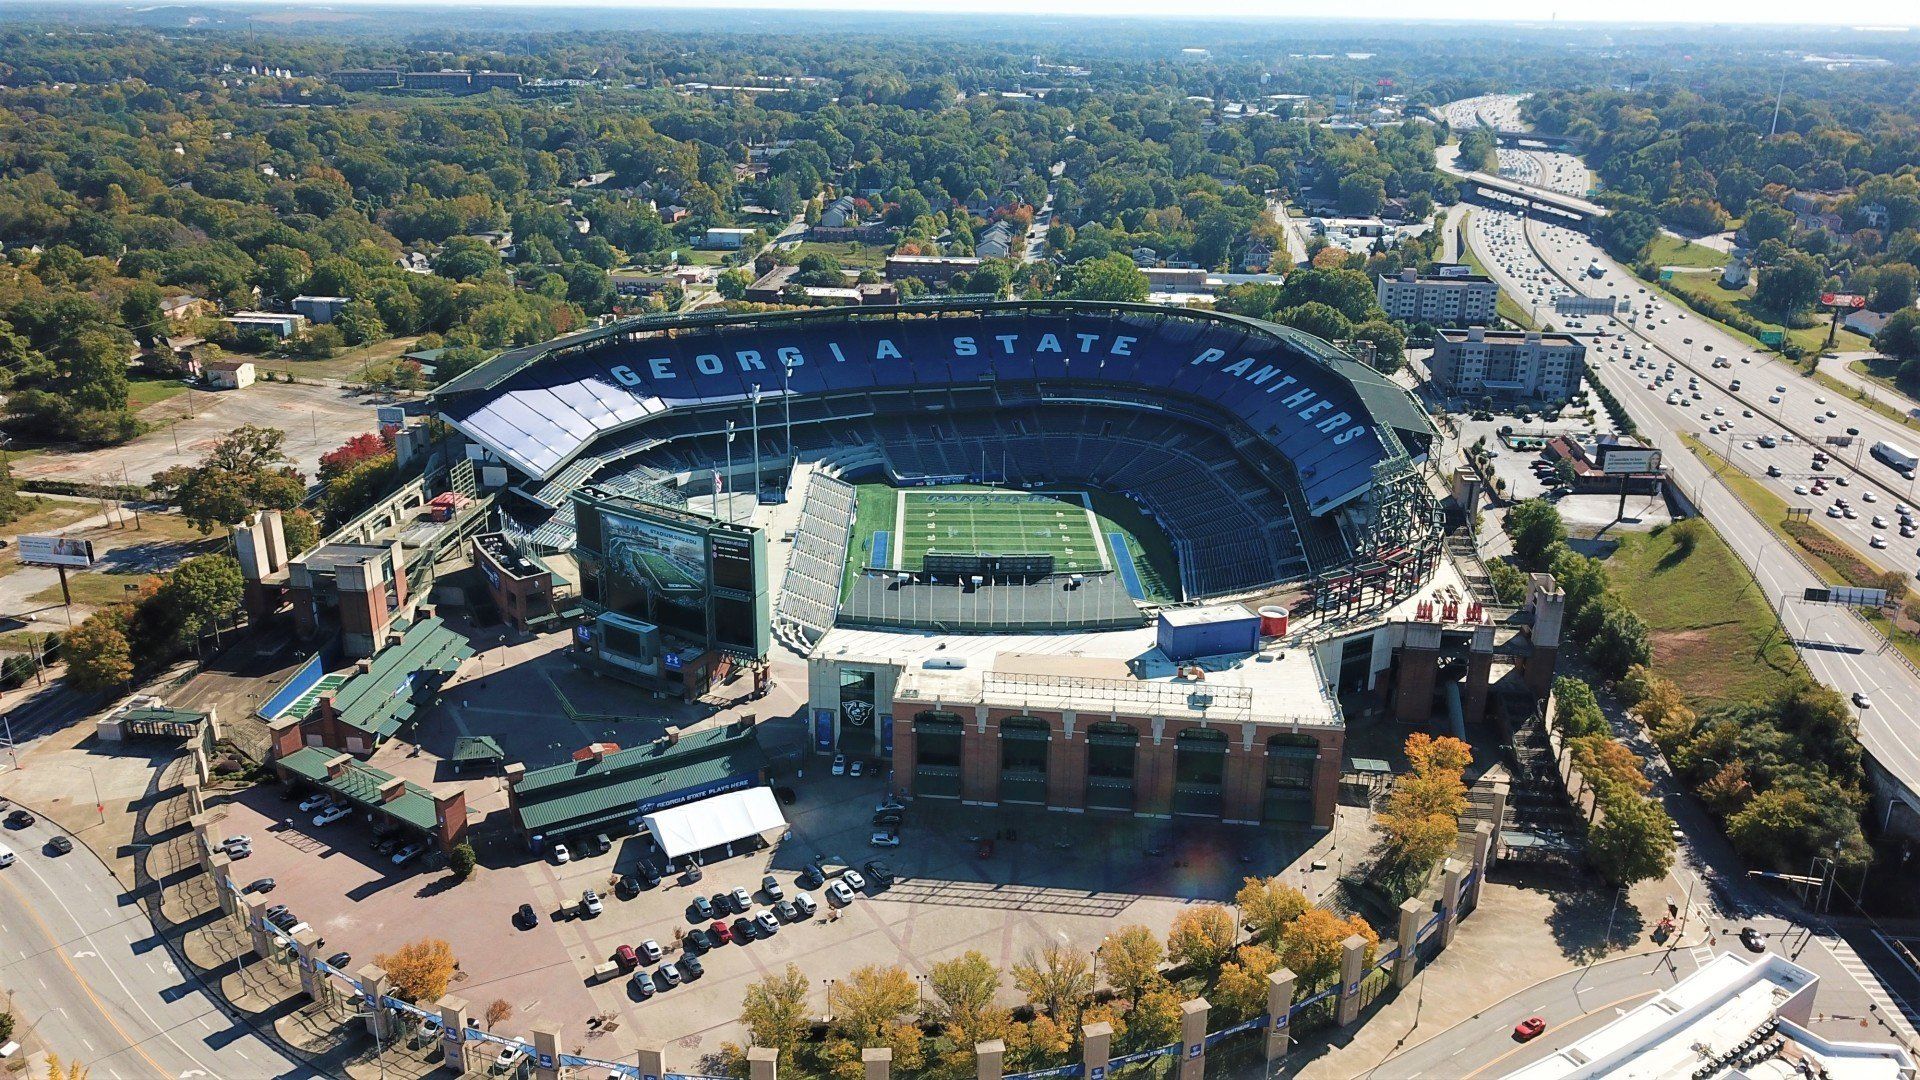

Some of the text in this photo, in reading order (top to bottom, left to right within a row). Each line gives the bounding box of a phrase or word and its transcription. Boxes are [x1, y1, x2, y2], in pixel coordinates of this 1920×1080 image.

[611, 333, 1366, 446] GEORGIA STATE PANTHERS
[656, 779, 749, 808] GEORGIA STATE PLAYS HERE
